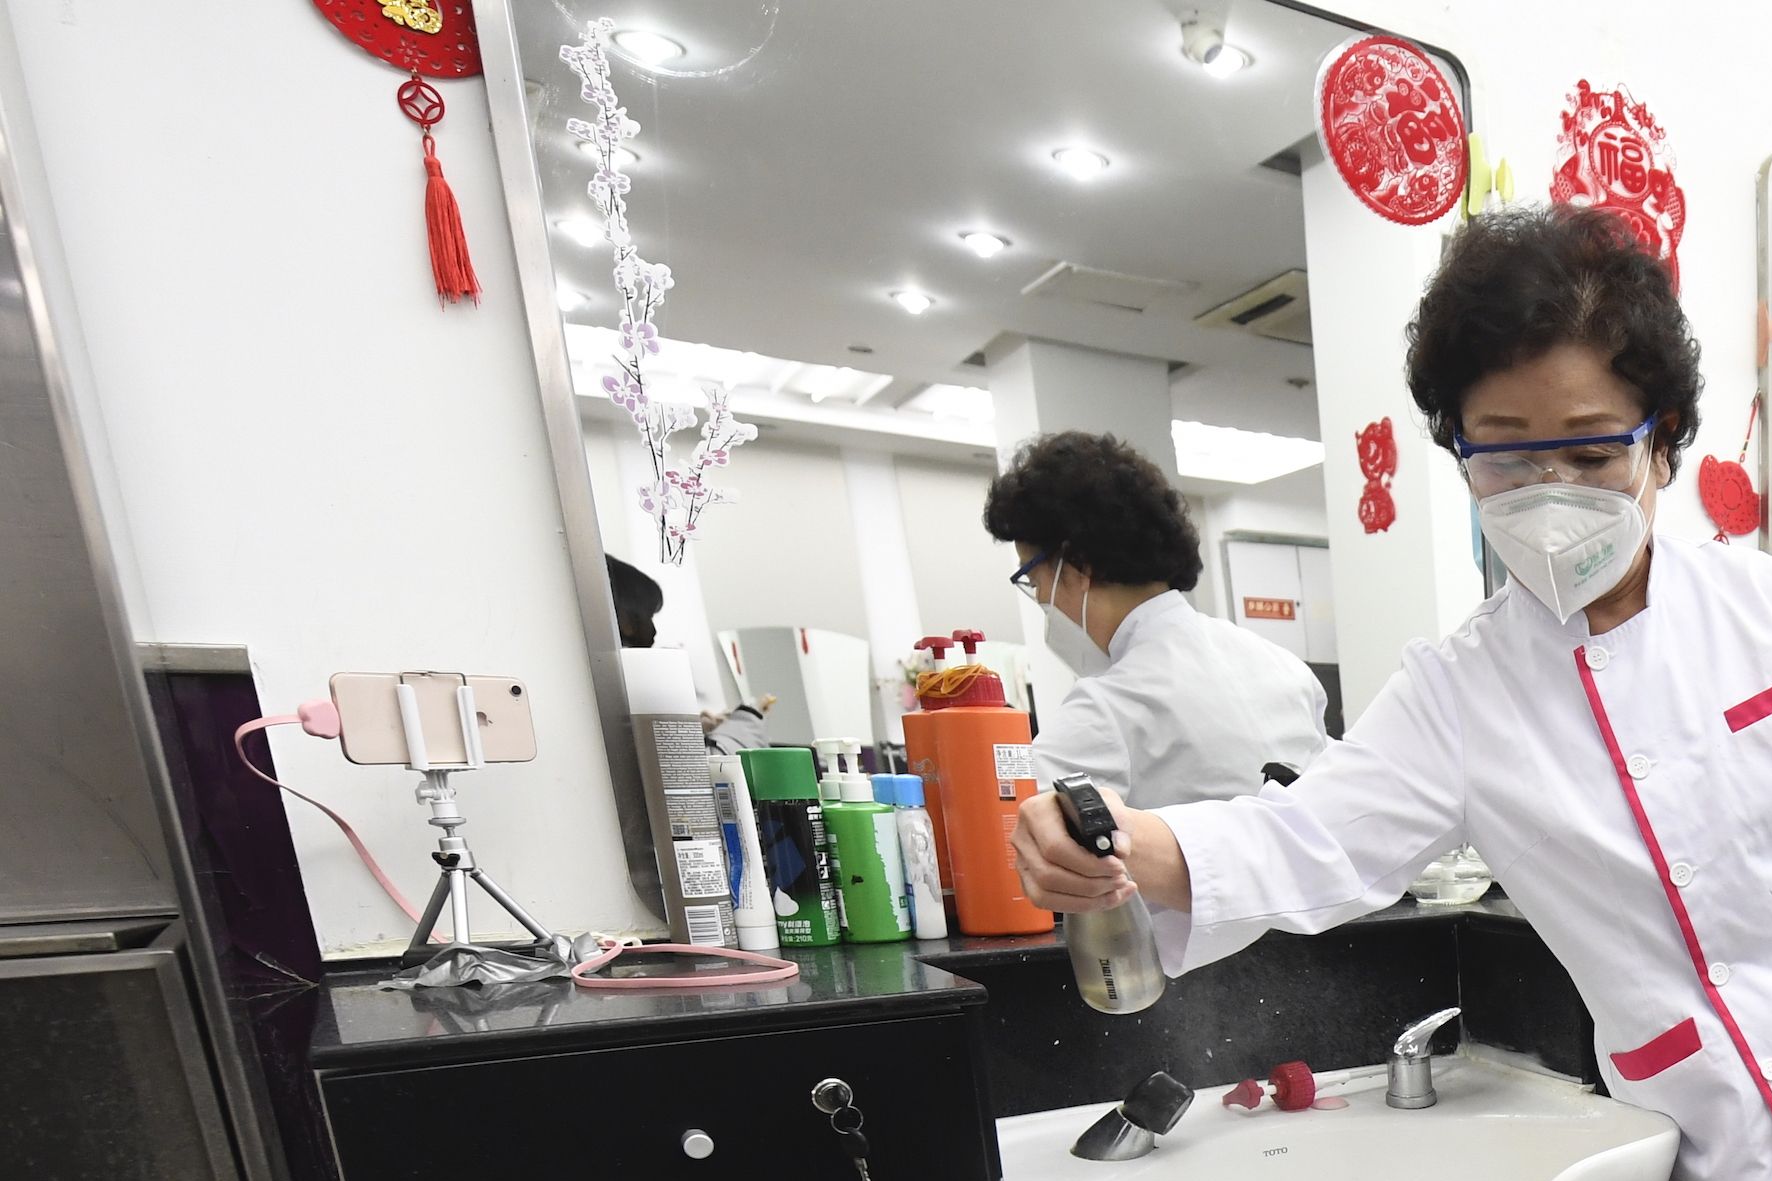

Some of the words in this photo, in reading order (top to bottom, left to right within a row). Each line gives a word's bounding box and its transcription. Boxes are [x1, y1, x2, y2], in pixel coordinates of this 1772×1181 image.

[1597, 132, 1648, 196] 福
[1104, 977, 1118, 1000] FORTRESS
[1263, 1147, 1288, 1157] TOTO
